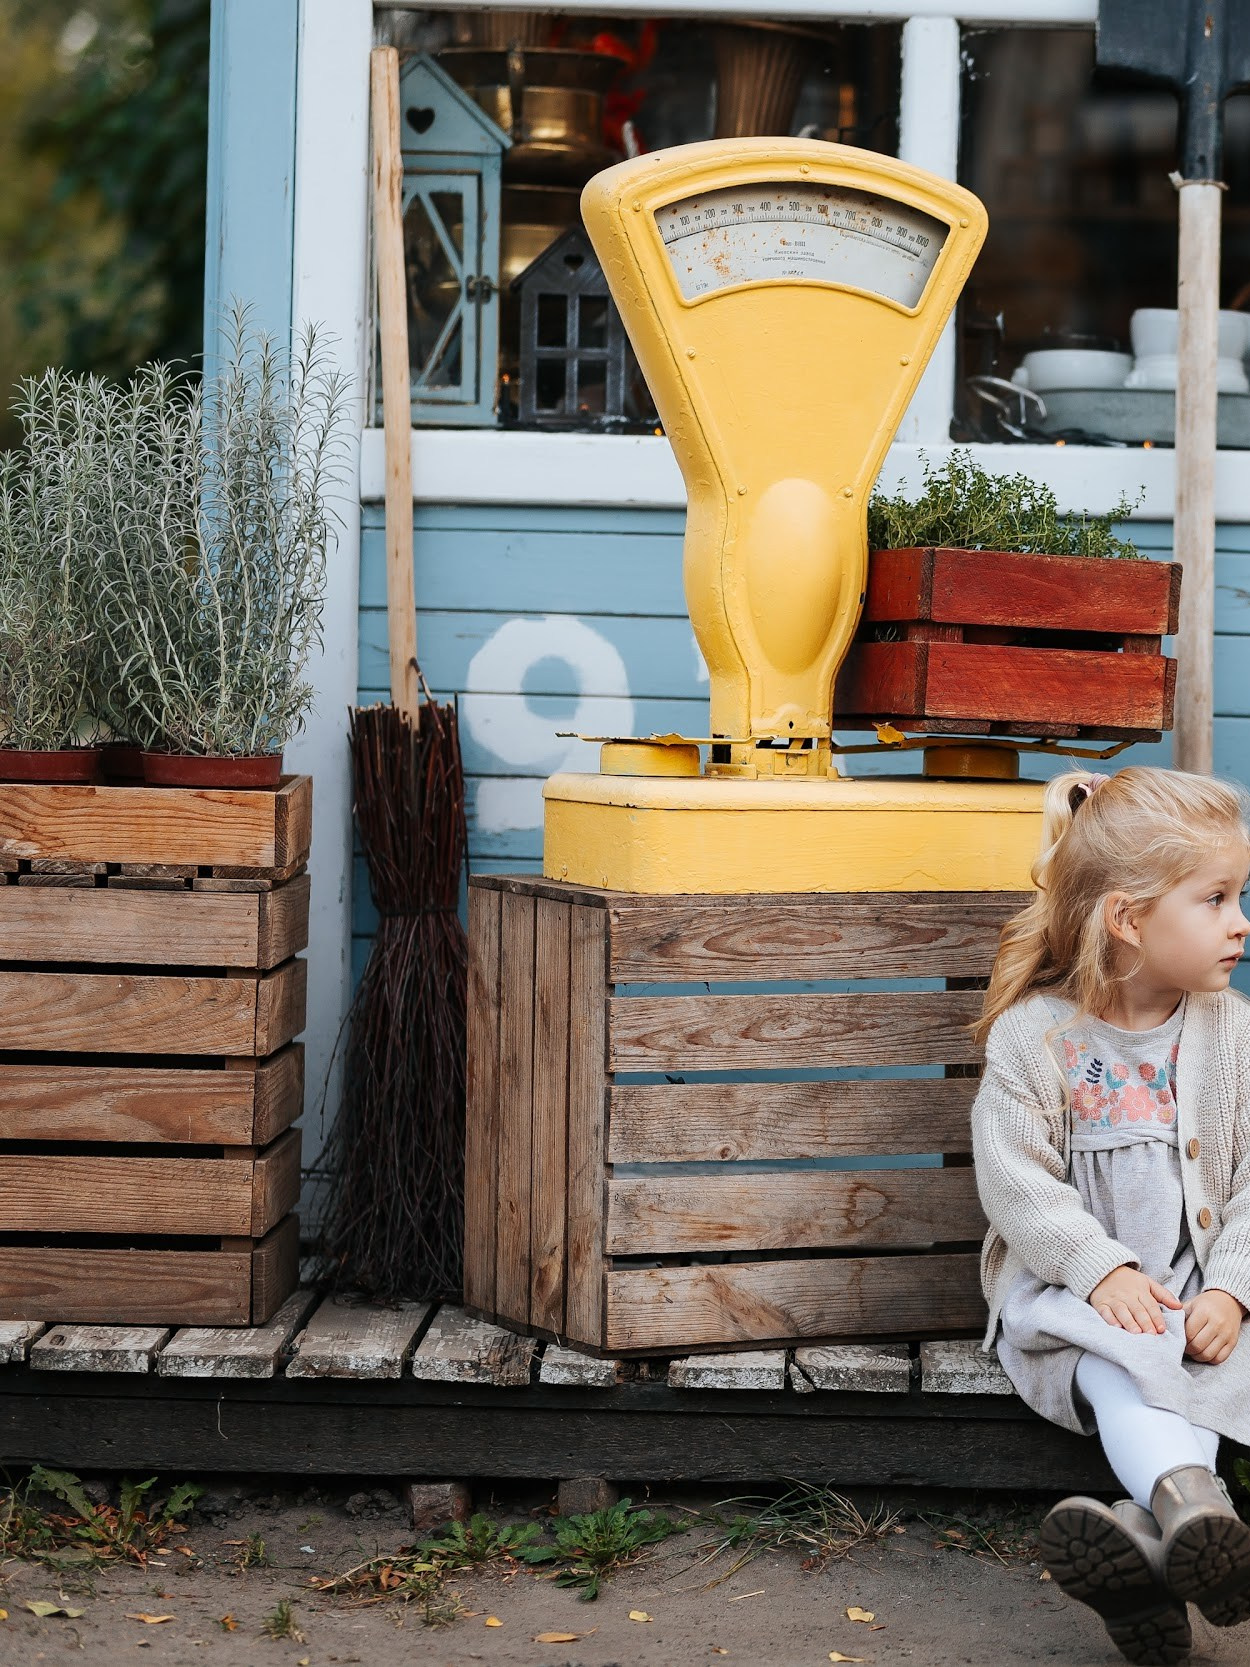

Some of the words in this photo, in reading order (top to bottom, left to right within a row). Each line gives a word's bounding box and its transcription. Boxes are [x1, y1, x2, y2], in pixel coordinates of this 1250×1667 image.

[680, 215, 690, 226] 100
[704, 208, 716, 220] 200
[732, 203, 744, 214] 300
[760, 201, 771, 211] 400
[789, 201, 800, 211] 500
[817, 203, 829, 214] 600
[844, 209, 857, 221] 700
[871, 216, 883, 228] 800
[896, 226, 908, 238] 900
[916, 234, 929, 248] 1000
